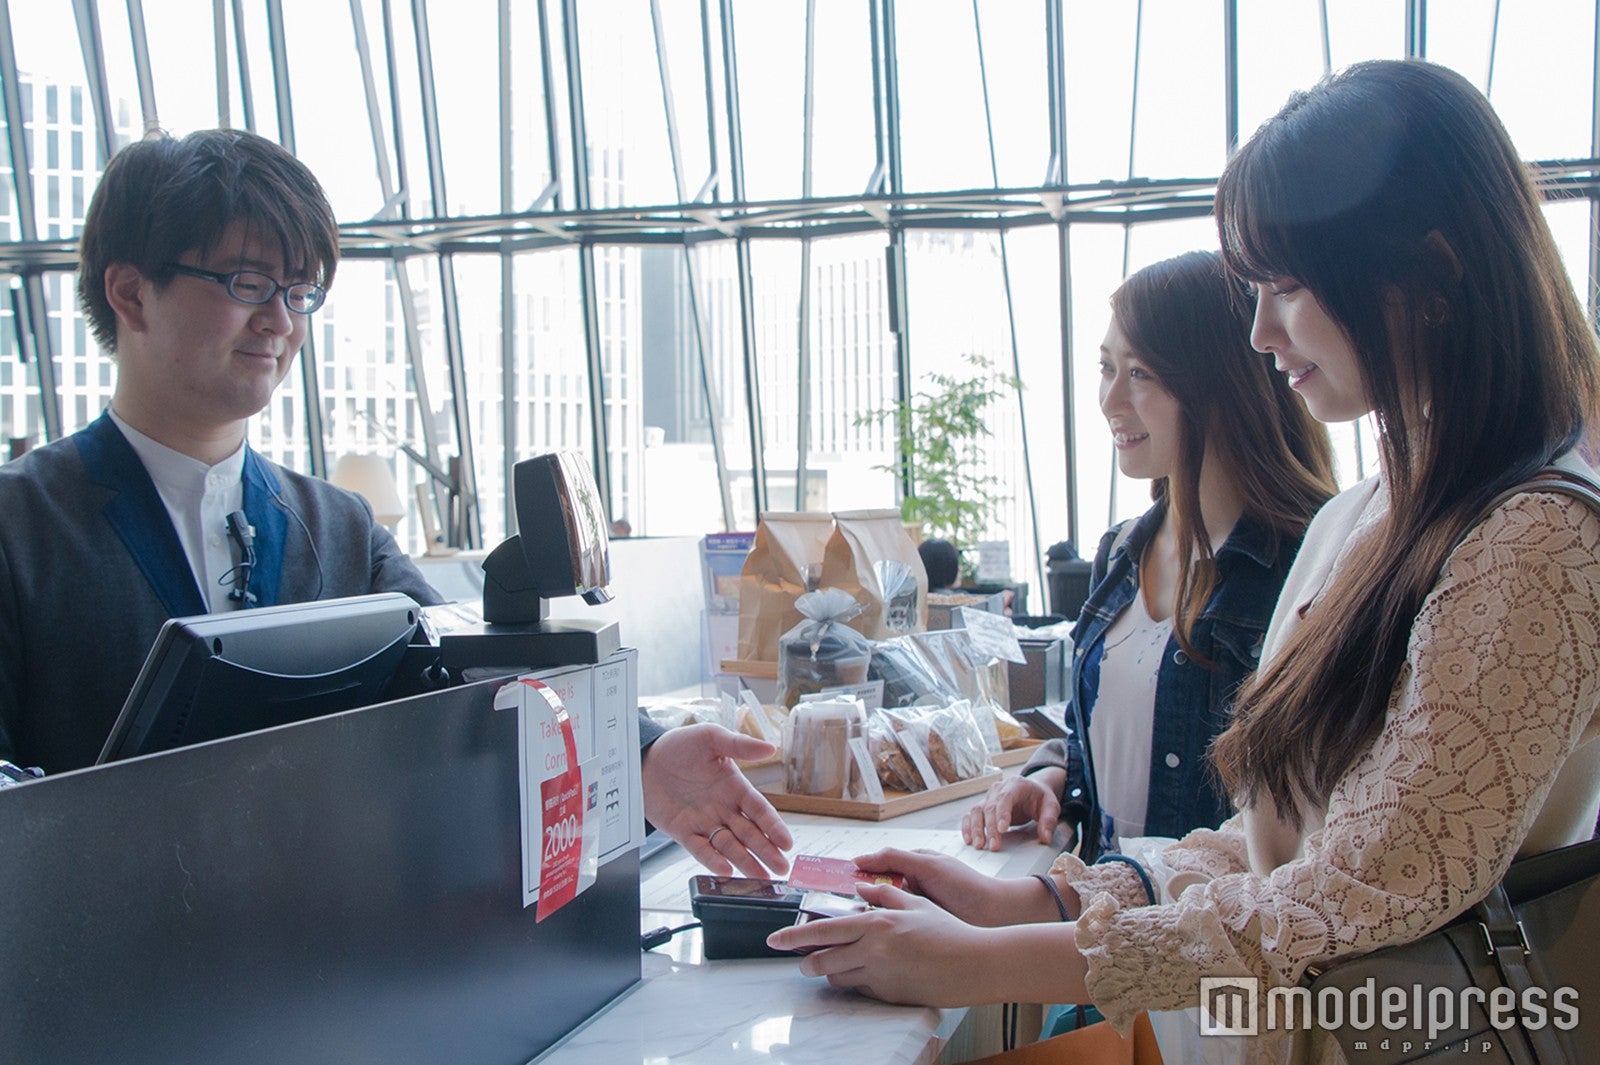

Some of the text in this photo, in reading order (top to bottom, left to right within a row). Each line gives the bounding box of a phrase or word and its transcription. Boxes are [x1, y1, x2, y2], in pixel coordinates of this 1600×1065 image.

[567, 682, 574, 699] is
[540, 718, 562, 739] Take
[544, 752, 566, 771] Corn
[544, 814, 576, 861] 2000
[799, 855, 822, 863] VISA
